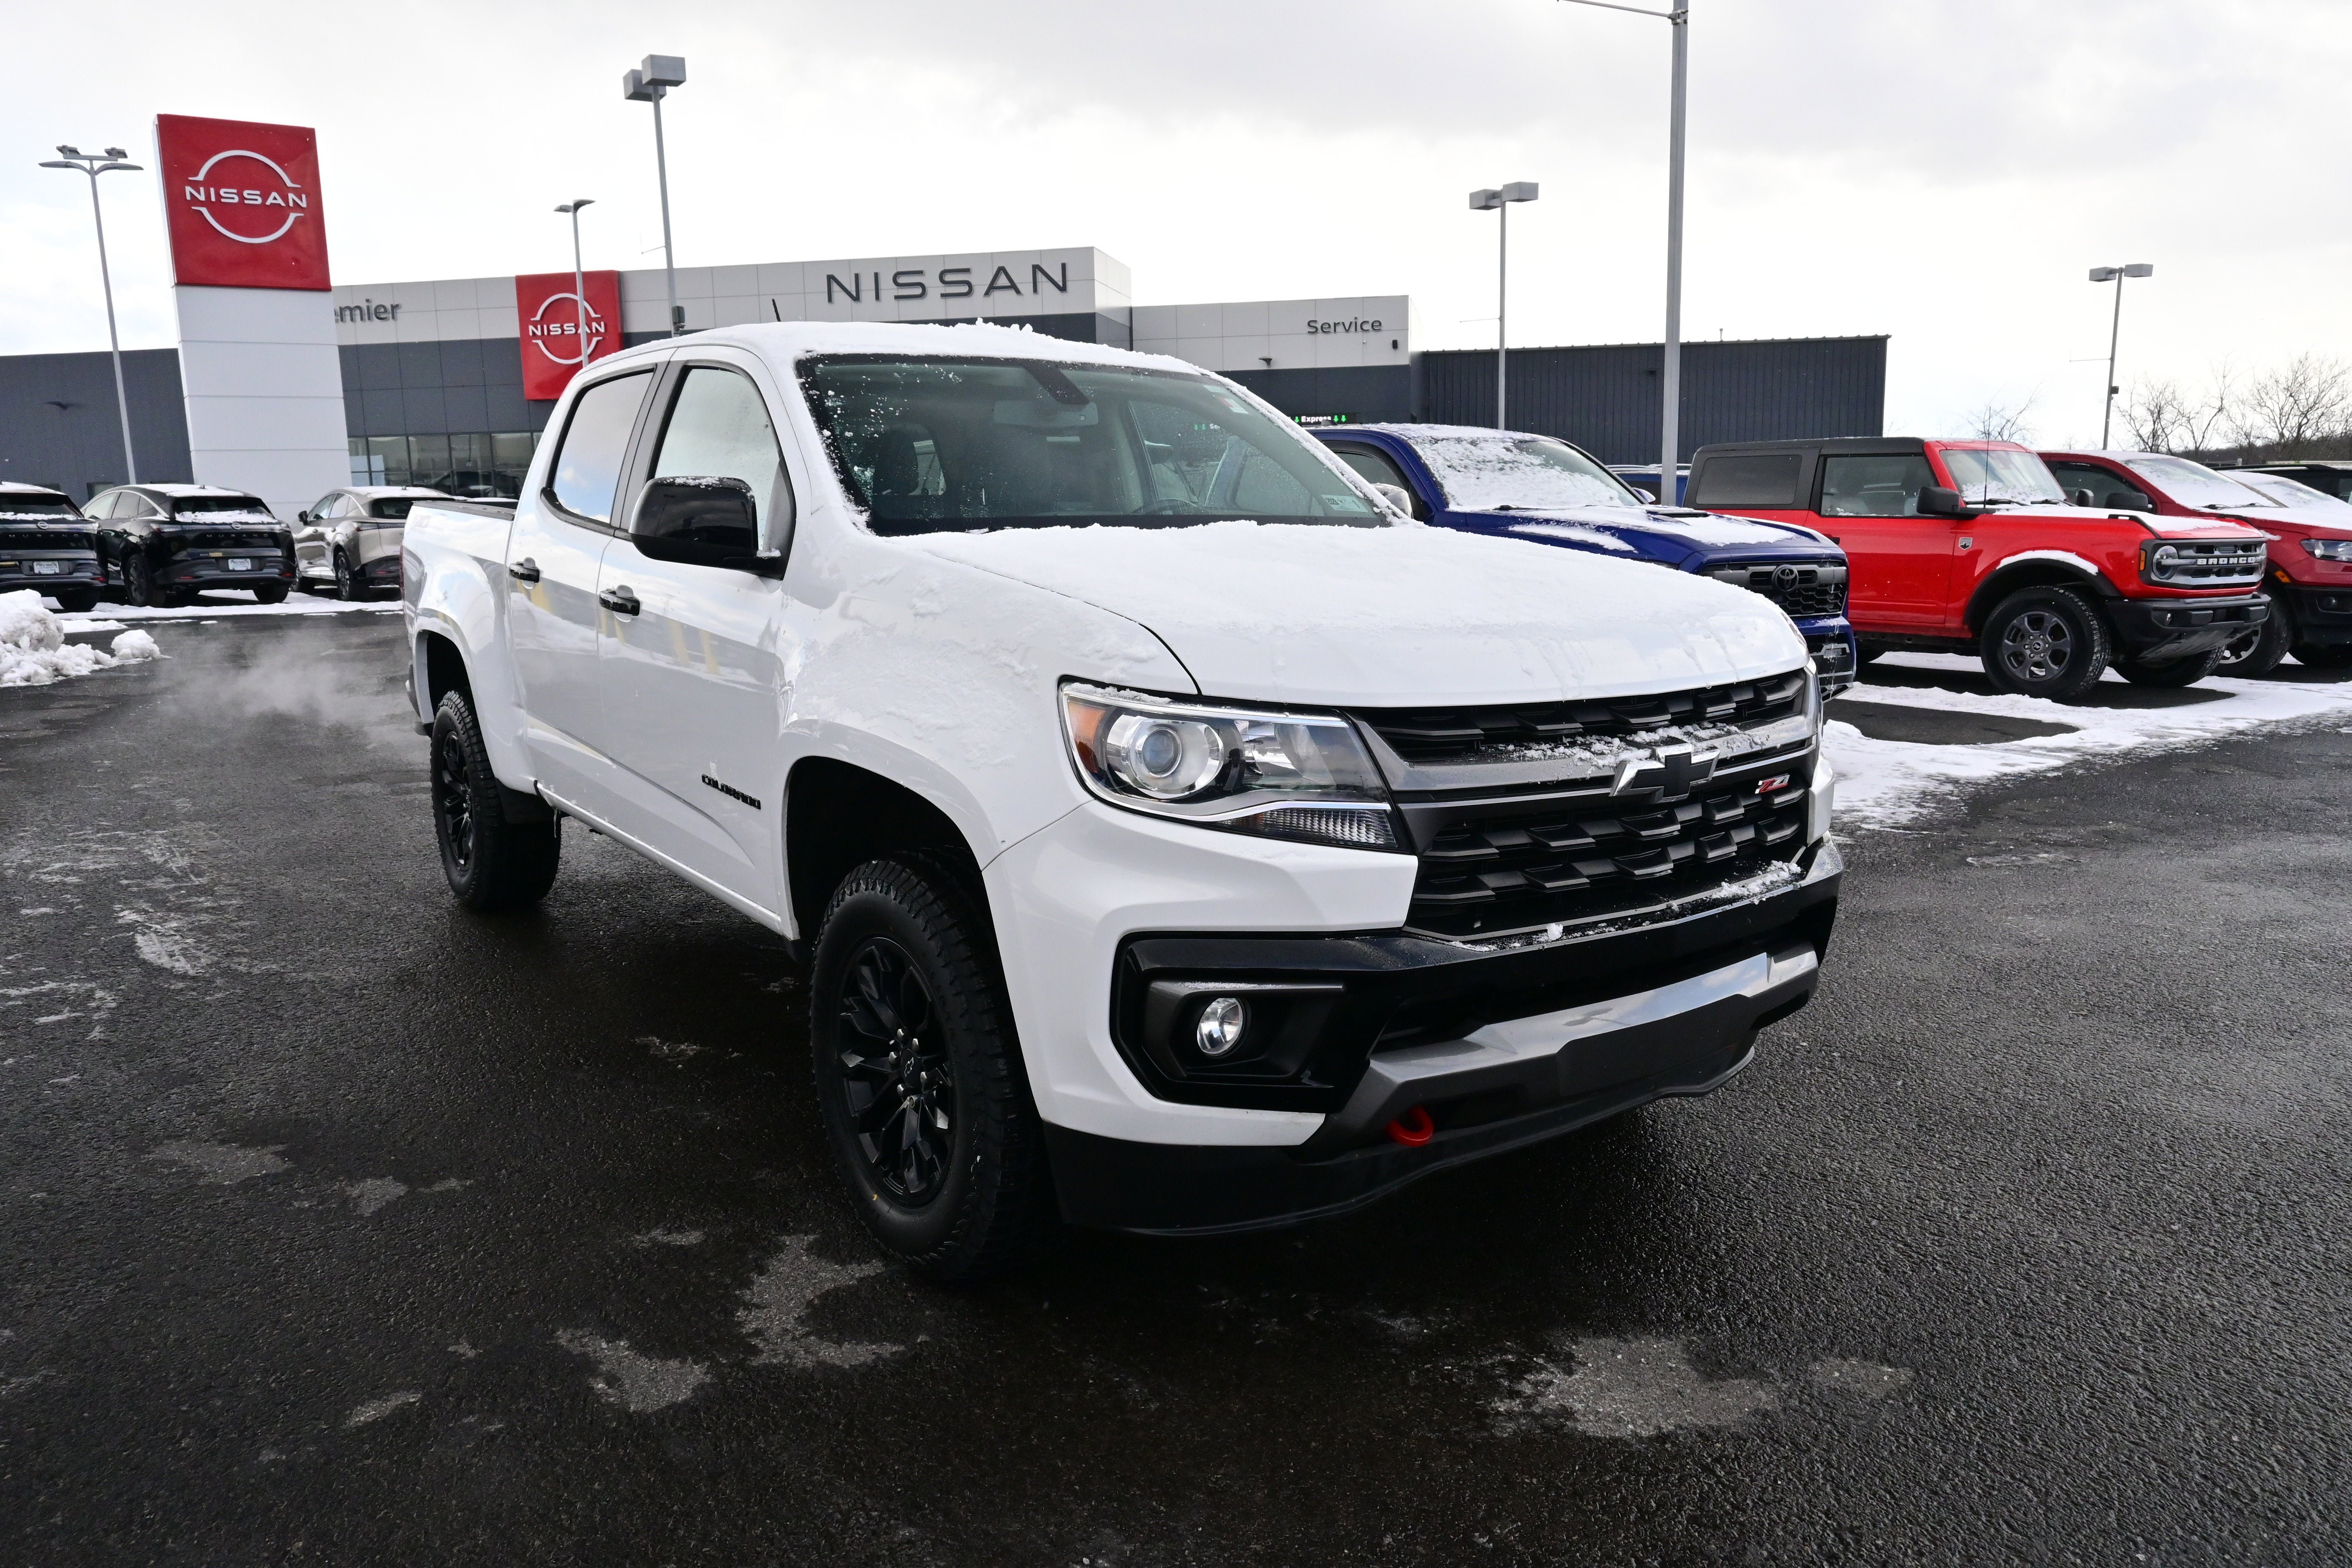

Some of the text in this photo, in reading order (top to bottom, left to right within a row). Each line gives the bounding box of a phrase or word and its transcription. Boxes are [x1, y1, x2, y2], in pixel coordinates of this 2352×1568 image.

[185, 186, 307, 208] NISSAN
[826, 262, 1067, 303] NISSAN
[334, 298, 401, 322] mier
[528, 321, 605, 336] NISSAN
[1307, 317, 1382, 334] Service
[1301, 416, 1331, 424] Express
[2197, 557, 2255, 565] BRONCO
[701, 774, 761, 810] COLORADO
